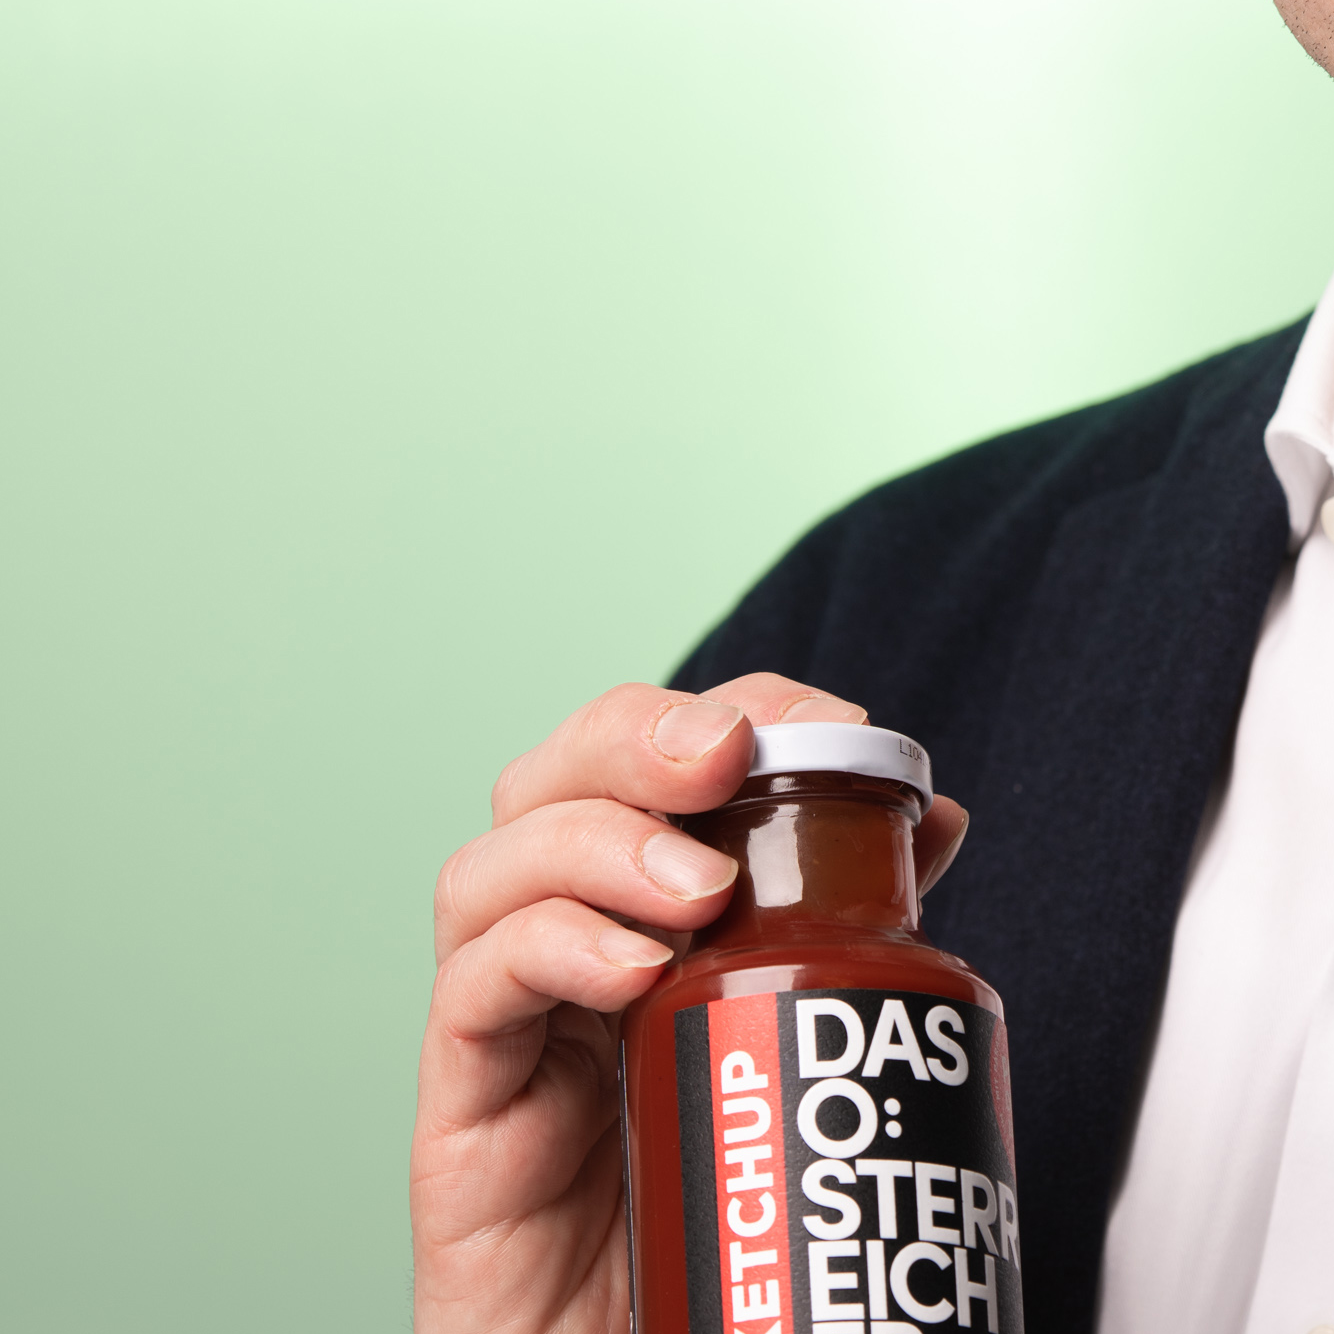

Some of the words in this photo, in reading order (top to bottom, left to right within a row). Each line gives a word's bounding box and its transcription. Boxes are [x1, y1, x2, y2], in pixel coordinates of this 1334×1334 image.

[796, 998, 969, 1086] DAS
[801, 1159, 1020, 1270] STERR
[808, 1240, 999, 1334] EICH
